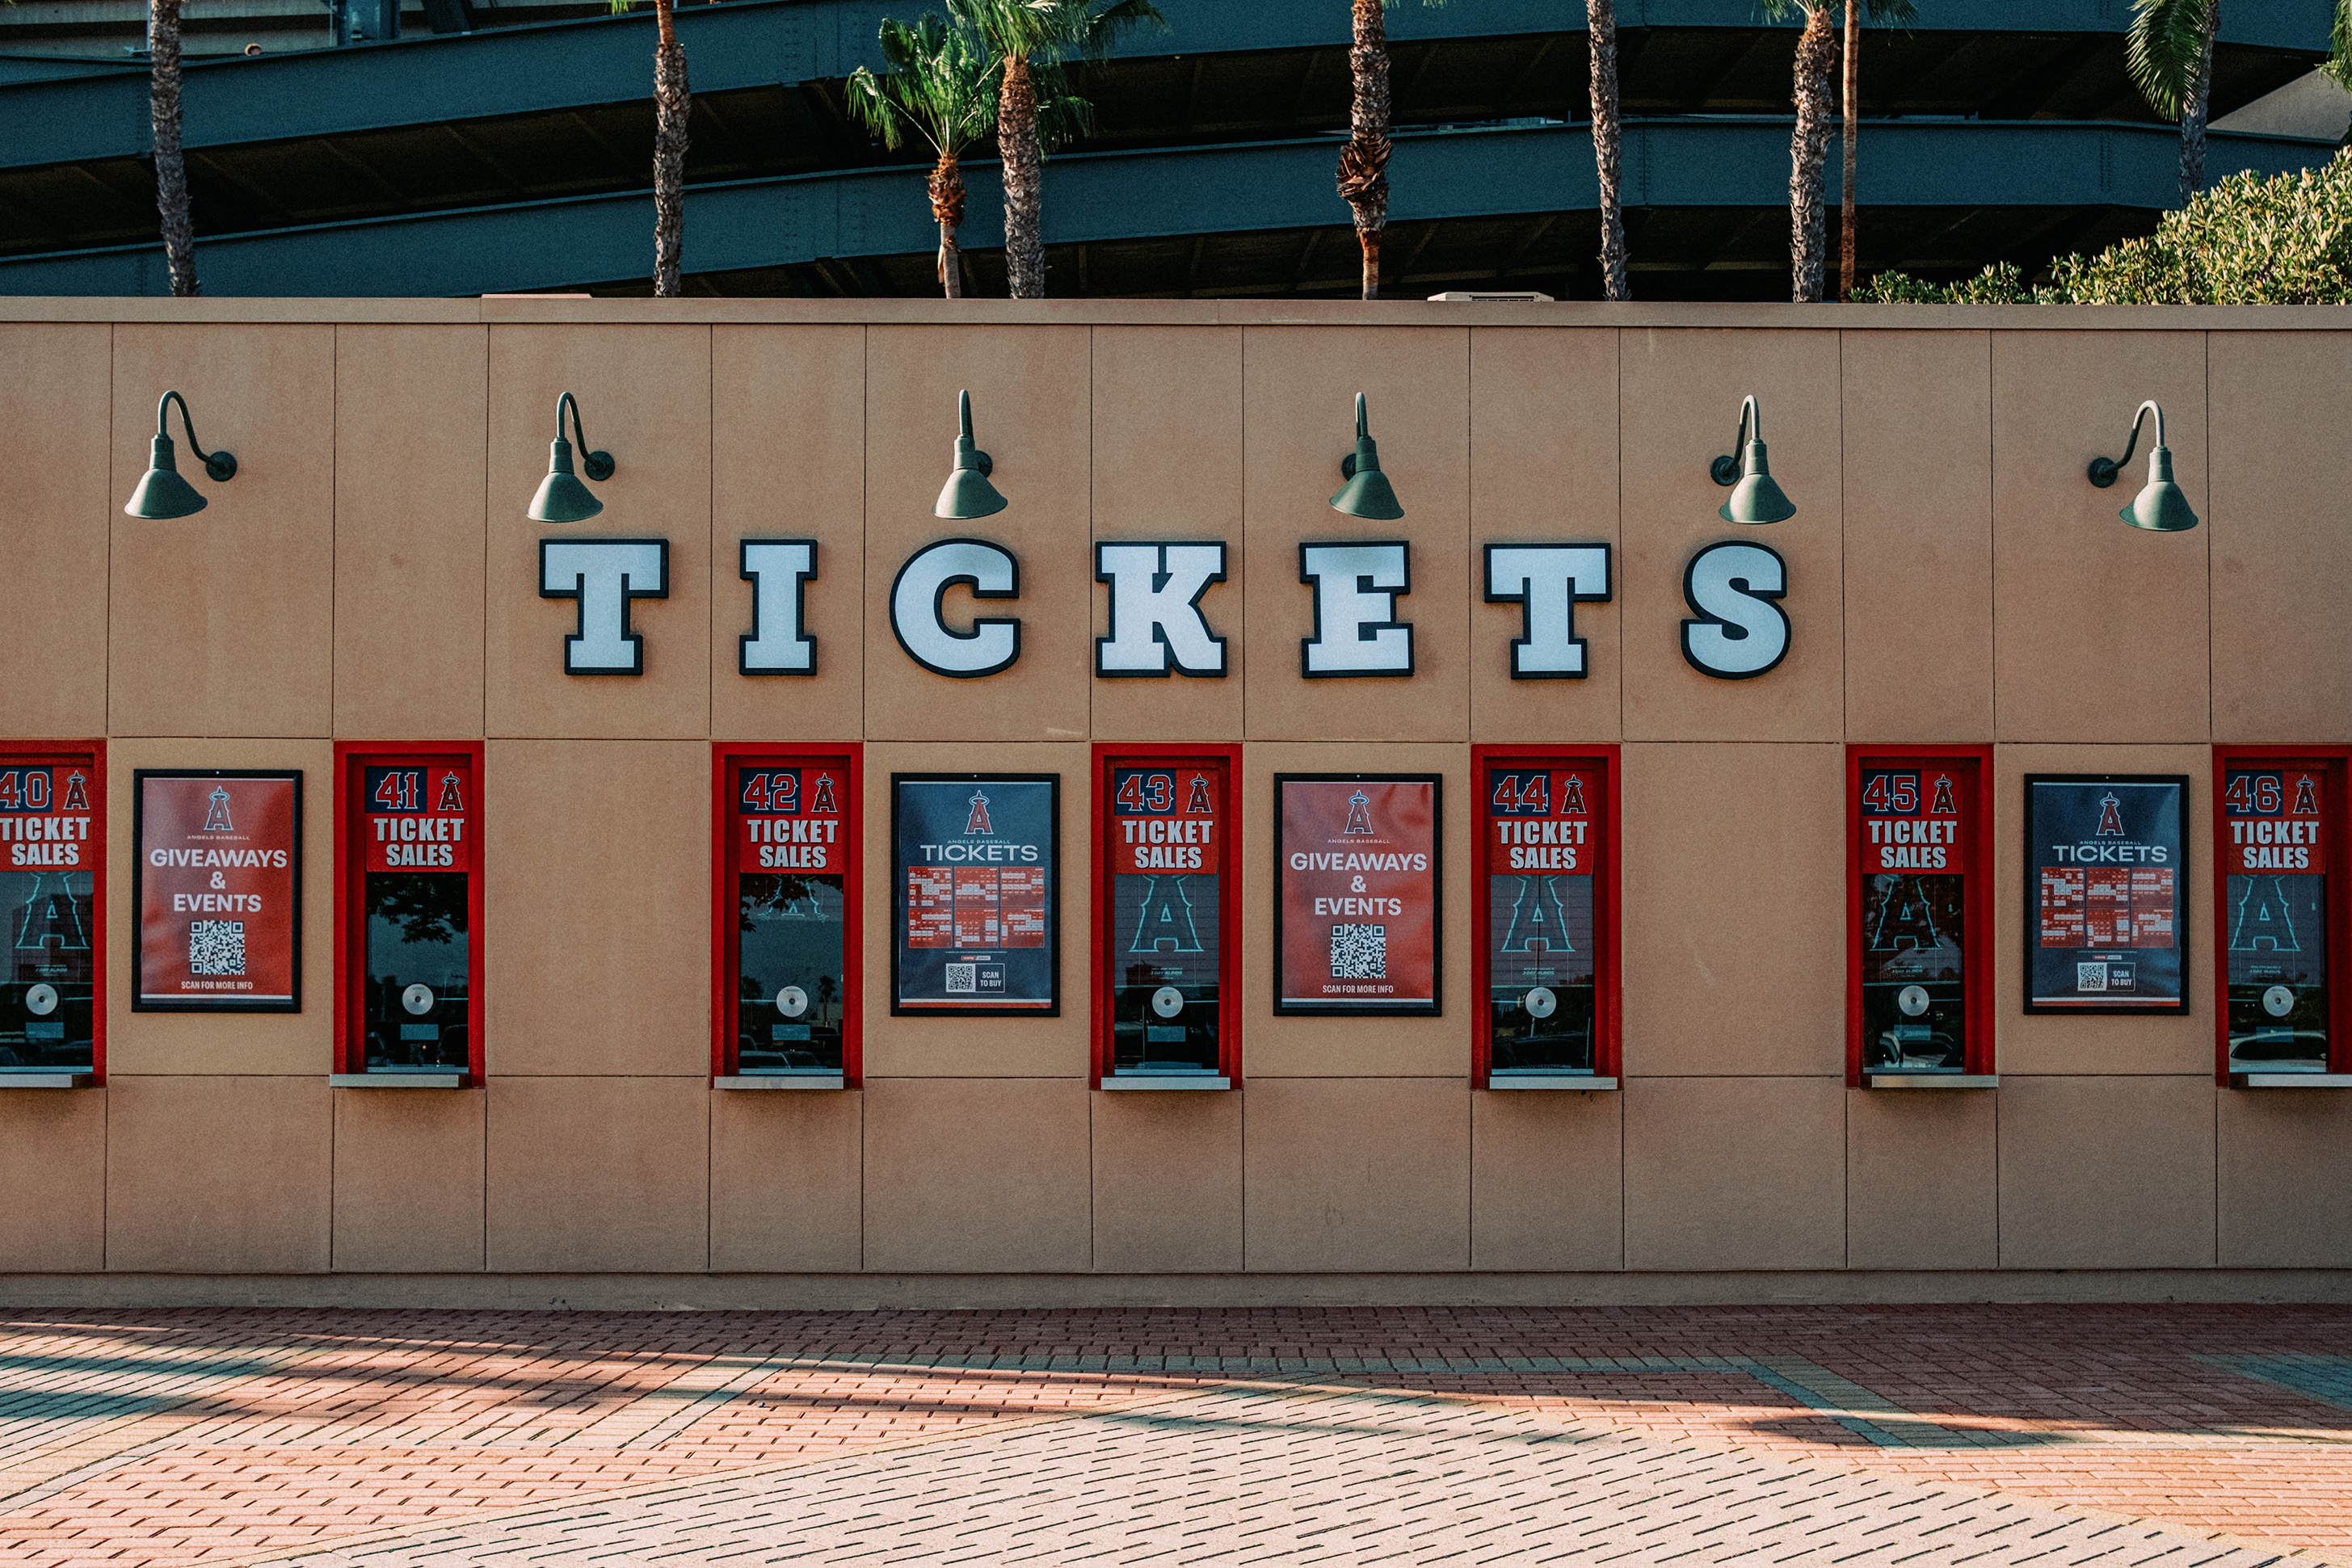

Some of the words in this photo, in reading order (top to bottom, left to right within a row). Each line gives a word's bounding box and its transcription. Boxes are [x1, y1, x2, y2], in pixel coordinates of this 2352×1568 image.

[539, 537, 1791, 679] TICKETS
[0, 771, 52, 808] 40
[376, 772, 419, 809] 41
[743, 774, 798, 810] 42
[1117, 774, 1174, 811] 43
[1493, 776, 1549, 812] 44
[1863, 776, 1919, 811] 45
[2226, 776, 2281, 812] 46
[0, 817, 90, 841] TICKET
[373, 818, 465, 841] TICKET
[747, 819, 838, 843] TICKET
[1122, 820, 1214, 844] TICKET
[1497, 821, 1588, 844] TICKET
[1868, 821, 1957, 843] TICKET
[2231, 821, 2319, 844] TICKET
[11, 843, 79, 865] SALES
[149, 848, 288, 868] GIVEAWAYS
[386, 843, 453, 866] SALES
[759, 845, 827, 868] SALES
[919, 845, 1038, 861] TICKETS
[1134, 847, 1202, 868] SALES
[1290, 852, 1427, 872] GIVEAWAYS
[1509, 847, 1576, 869] SALES
[1880, 846, 1946, 868] SALES
[2053, 845, 2168, 862] TICKETS
[2243, 847, 2309, 868] SALES
[210, 871, 225, 889] &
[1350, 875, 1366, 893] &
[173, 893, 262, 913] EVENTS
[1315, 898, 1402, 916] EVENTS
[181, 981, 200, 990] SCAN
[201, 981, 215, 990] FOR
[216, 981, 236, 990] MORE
[237, 982, 253, 990] INFO
[982, 971, 999, 979] SCAN
[1323, 985, 1341, 993] SCAN
[1342, 985, 1356, 993] FOR
[1357, 985, 1376, 993] MORE
[1378, 985, 1394, 993] INFO
